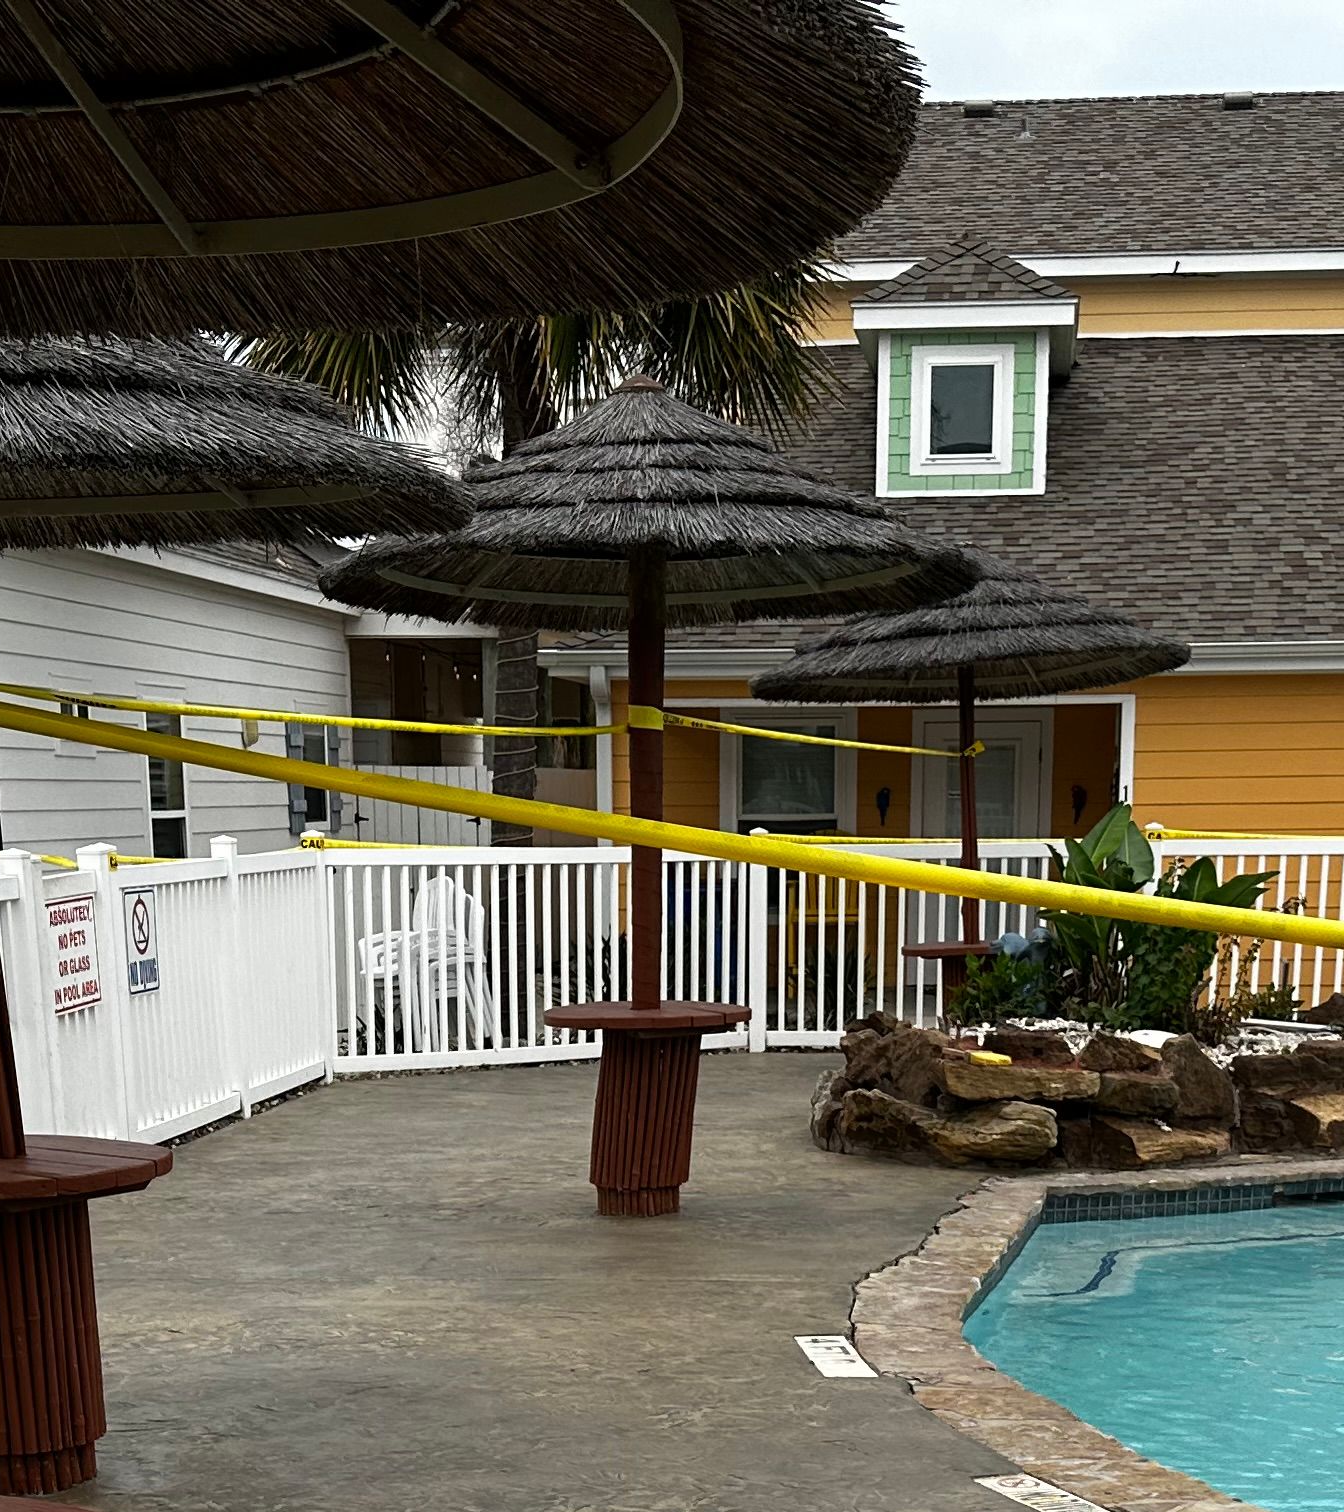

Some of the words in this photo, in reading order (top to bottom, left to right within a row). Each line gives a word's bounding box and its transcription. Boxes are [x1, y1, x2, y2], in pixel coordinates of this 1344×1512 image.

[49, 903, 92, 927] ABSOLUTELY
[58, 934, 68, 950] NO
[69, 929, 86, 948] PETS
[58, 960, 69, 977] OR
[70, 954, 90, 974] GLASS
[55, 988, 62, 1005] IN
[63, 984, 81, 1003] POOL
[82, 979, 99, 998] AREA
